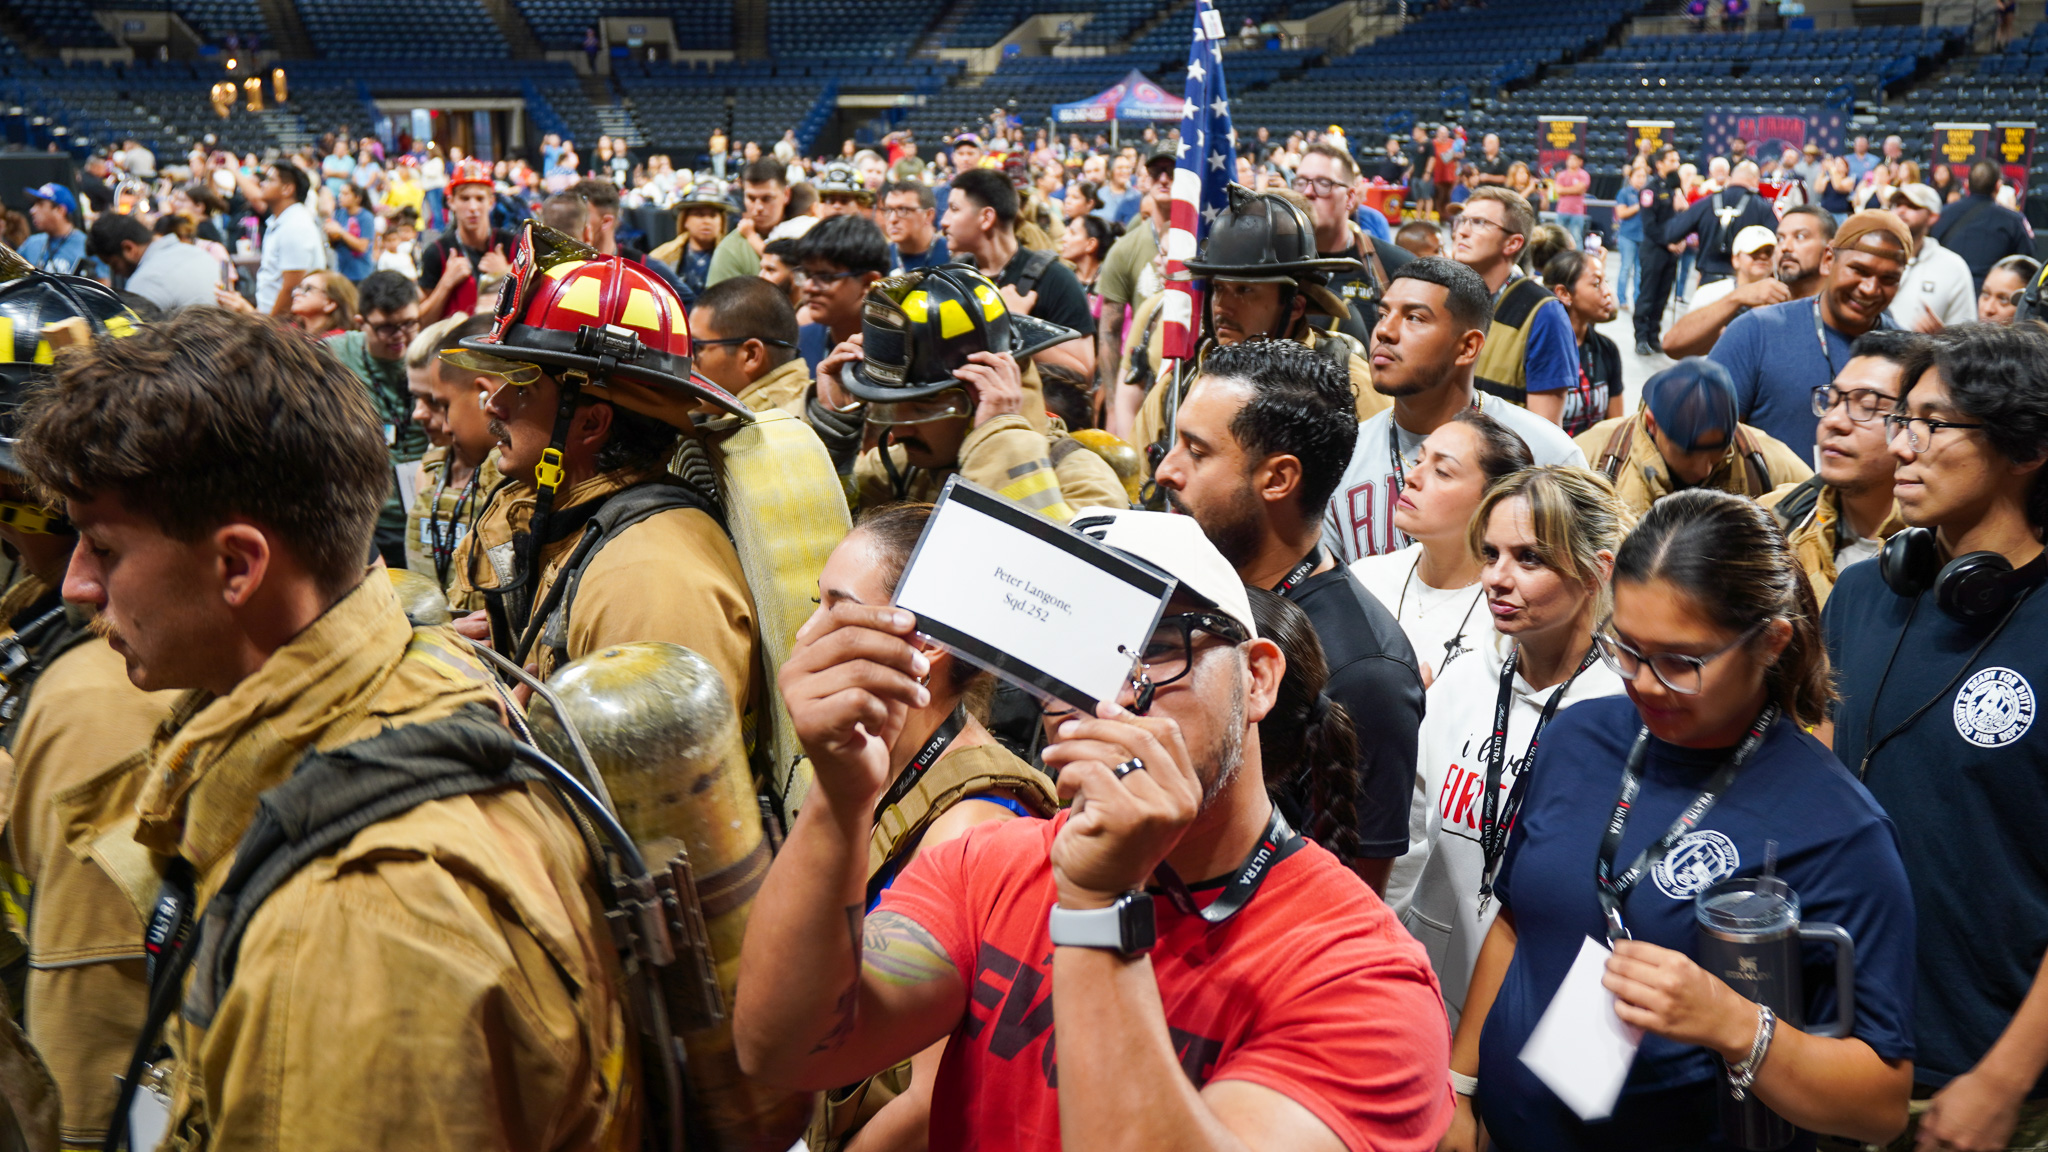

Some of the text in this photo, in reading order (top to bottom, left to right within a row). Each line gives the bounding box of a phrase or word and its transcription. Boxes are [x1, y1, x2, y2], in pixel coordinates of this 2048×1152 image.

[1287, 562, 1314, 585] ULTRA
[993, 566, 1073, 616] Peter Langone,
[1026, 603, 1050, 623] 252
[1583, 647, 1600, 667] ULTR
[1967, 670, 1998, 691] READY
[1998, 671, 2019, 686] FOR
[2014, 684, 2032, 712] DUTY
[1957, 703, 2025, 744] LAREDO FIRE DEPT.
[918, 736, 947, 766] ULTRA
[1492, 736, 1503, 764] ULTRA
[1523, 746, 1538, 773] ULTRA
[1609, 806, 1628, 835] ULTRA
[1687, 792, 1715, 821] ULTRA
[1484, 823, 1493, 851] ULTRA
[1239, 848, 1271, 885] ULTRA
[1613, 867, 1641, 892] ULTRA
[147, 896, 179, 944] ULTRA
